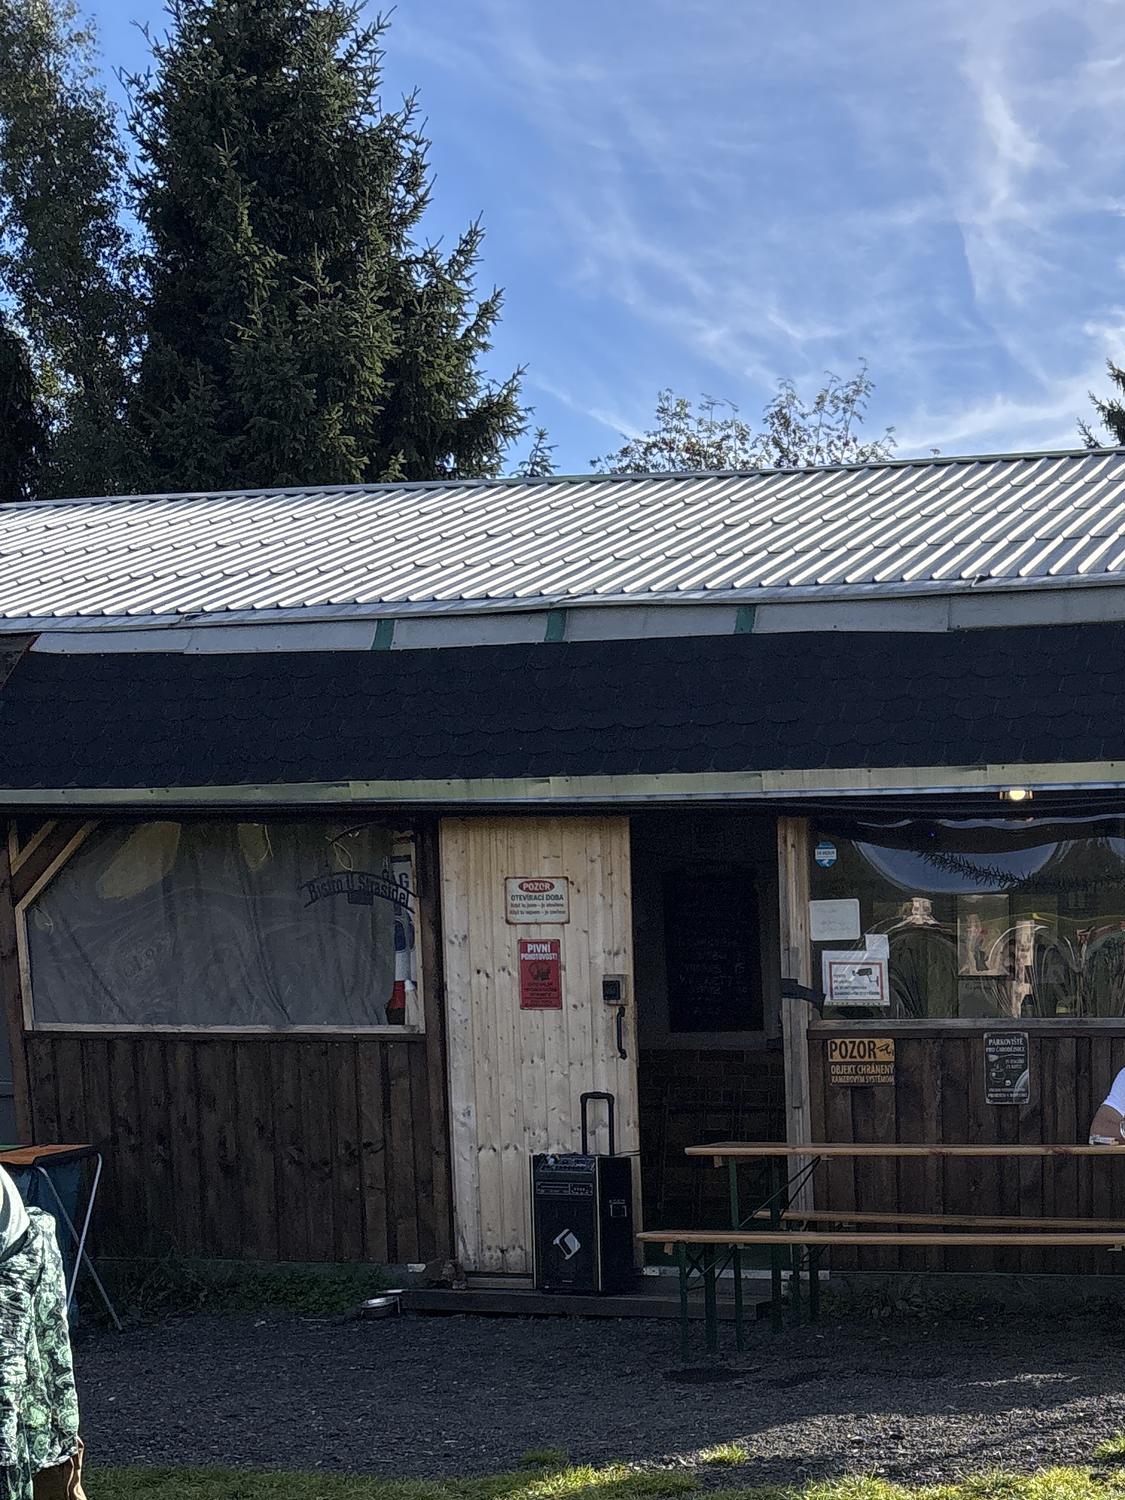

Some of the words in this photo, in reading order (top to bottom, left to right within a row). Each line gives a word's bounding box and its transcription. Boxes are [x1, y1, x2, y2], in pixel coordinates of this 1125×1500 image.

[308, 878, 344, 901] Bistro
[346, 872, 355, 891] U
[522, 882, 551, 891] POZOR
[527, 941, 551, 953] PIVNÍ
[829, 1040, 877, 1059] POZOR
[830, 1064, 856, 1074] OBJEKT
